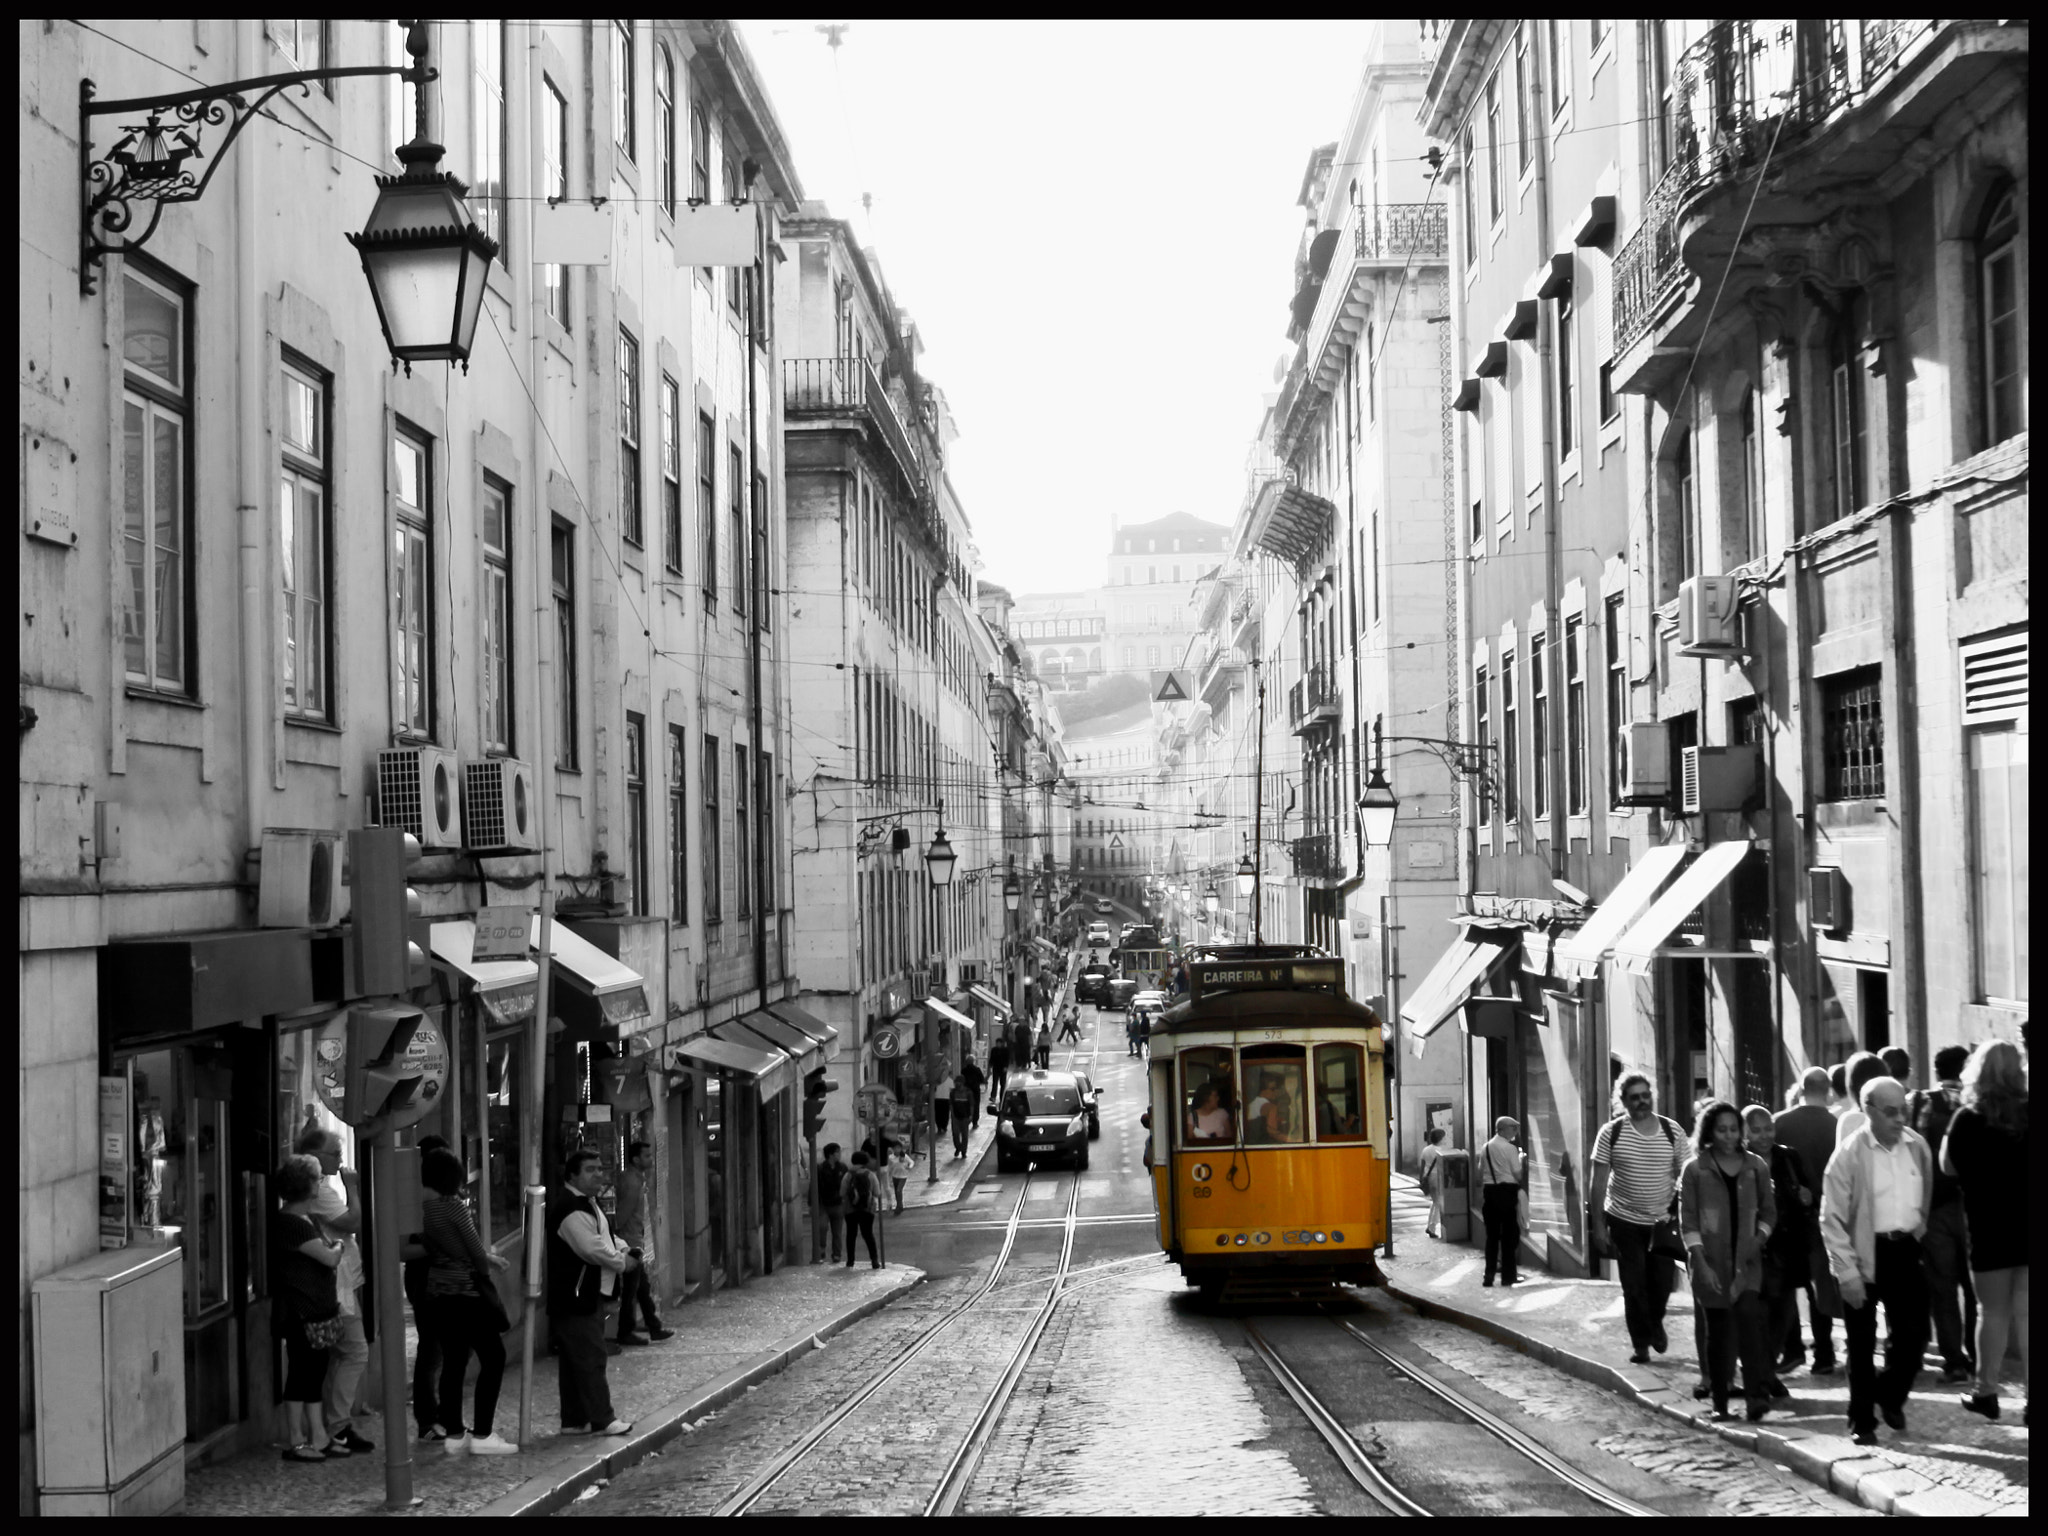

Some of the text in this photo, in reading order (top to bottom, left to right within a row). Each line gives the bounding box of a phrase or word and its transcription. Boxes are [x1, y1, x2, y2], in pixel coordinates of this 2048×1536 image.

[1203, 970, 1264, 984] CARREIRA
[1265, 1031, 1282, 1040] 573
[615, 1074, 626, 1095] 7
